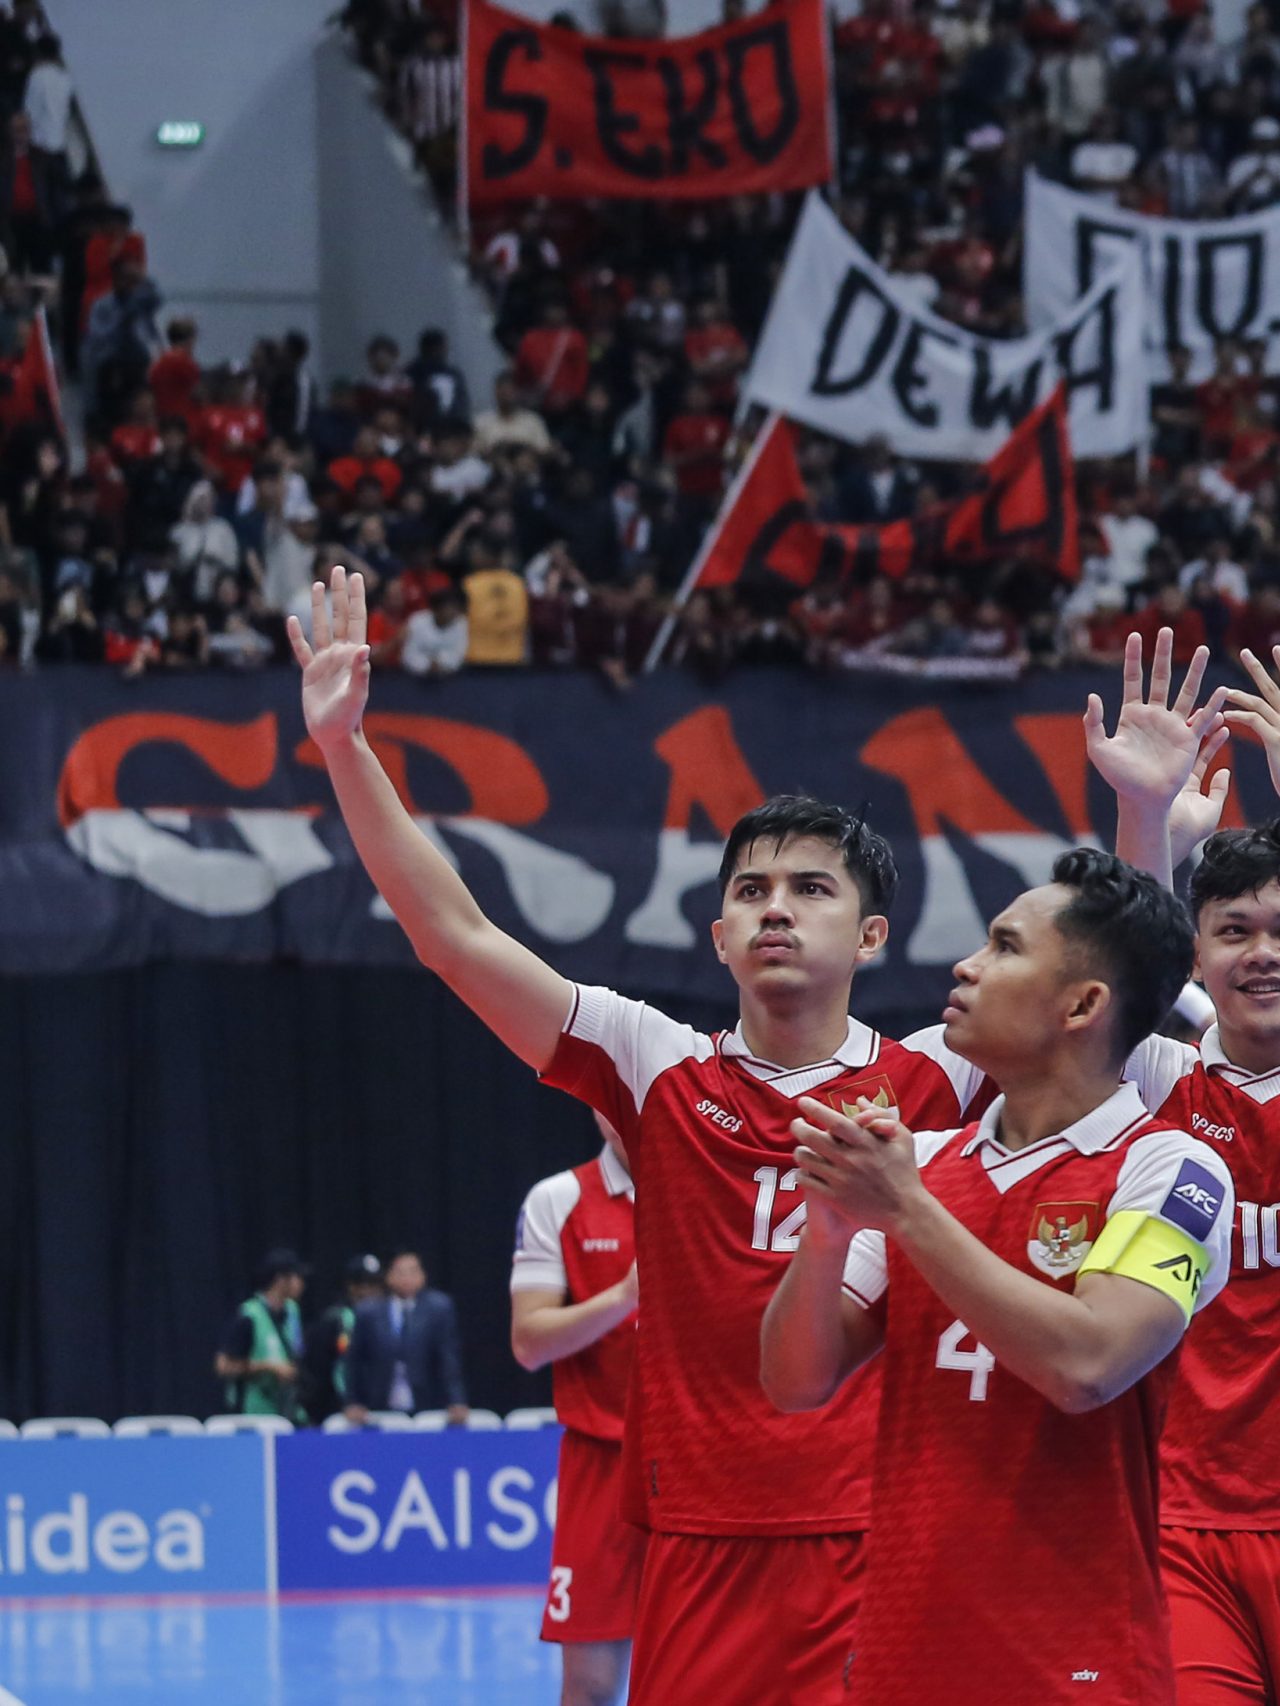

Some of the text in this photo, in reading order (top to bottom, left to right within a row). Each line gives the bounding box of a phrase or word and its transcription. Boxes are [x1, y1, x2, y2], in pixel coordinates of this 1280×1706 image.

[483, 20, 800, 180] S.EKO
[810, 264, 1116, 428] DEWA
[695, 1099, 743, 1133] SPECS
[1191, 1112, 1236, 1142] SPECS
[751, 1166, 808, 1252] 12
[1174, 1181, 1219, 1215] AFC
[935, 1319, 997, 1401] 4
[0, 1493, 206, 1575] idea
[327, 1467, 557, 1554] SAIS
[547, 1565, 573, 1623] 3
